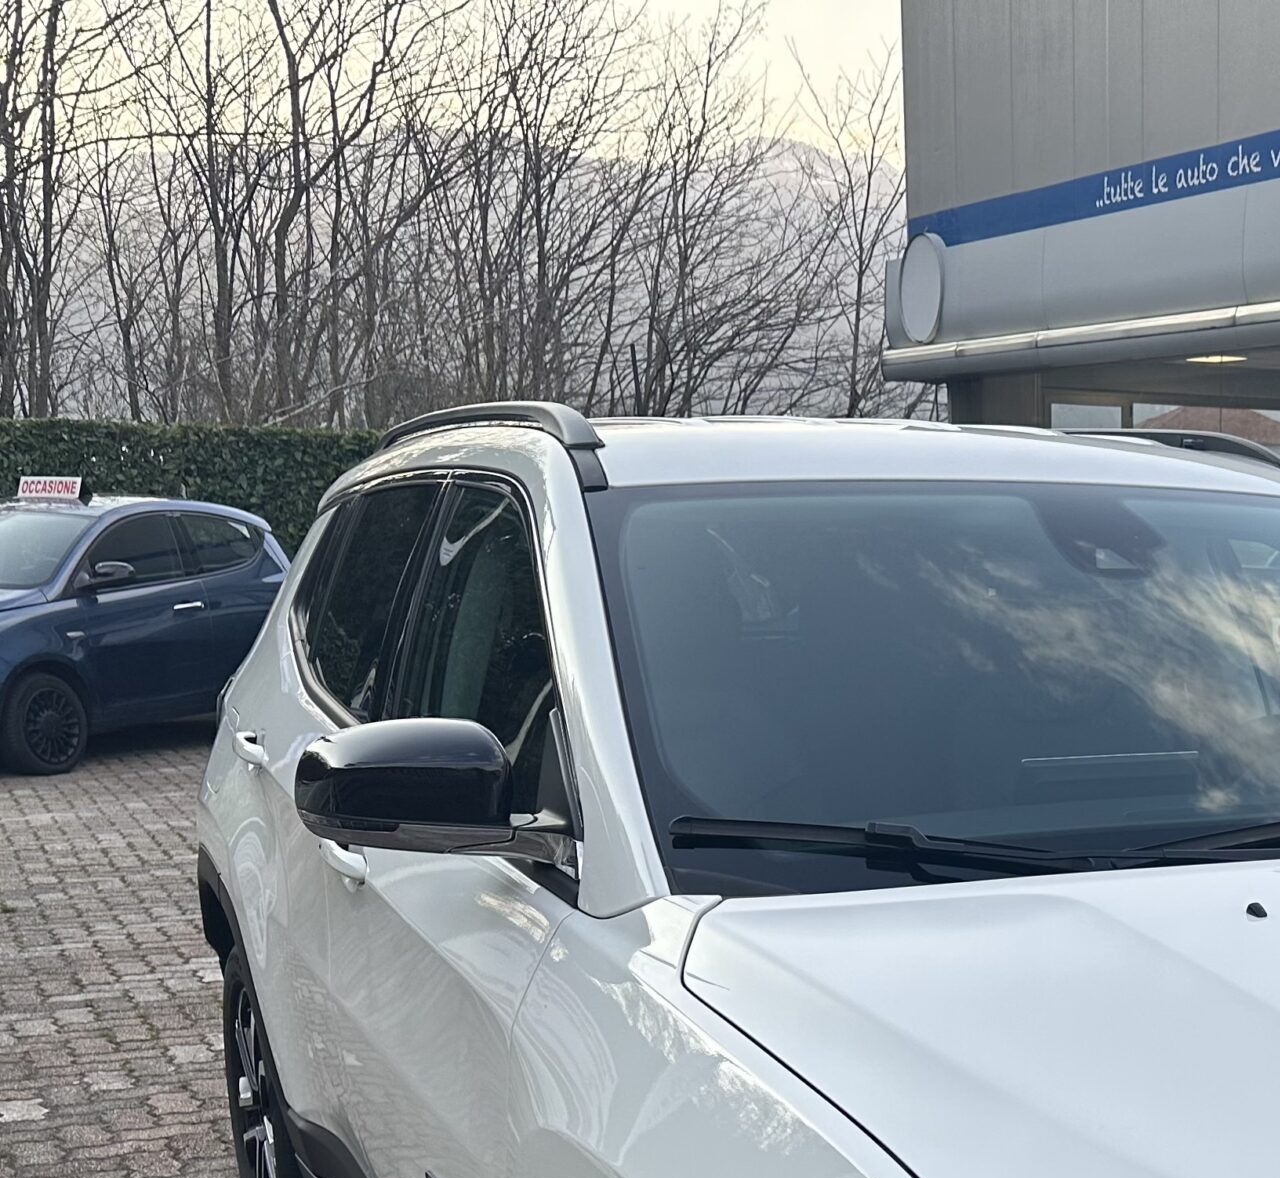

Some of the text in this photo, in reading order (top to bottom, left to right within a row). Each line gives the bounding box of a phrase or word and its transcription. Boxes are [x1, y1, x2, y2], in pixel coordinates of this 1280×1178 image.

[1152, 165, 1168, 194] le
[1176, 153, 1218, 189] auto
[1227, 144, 1261, 177] che
[21, 480, 77, 494] OCCASIONE
